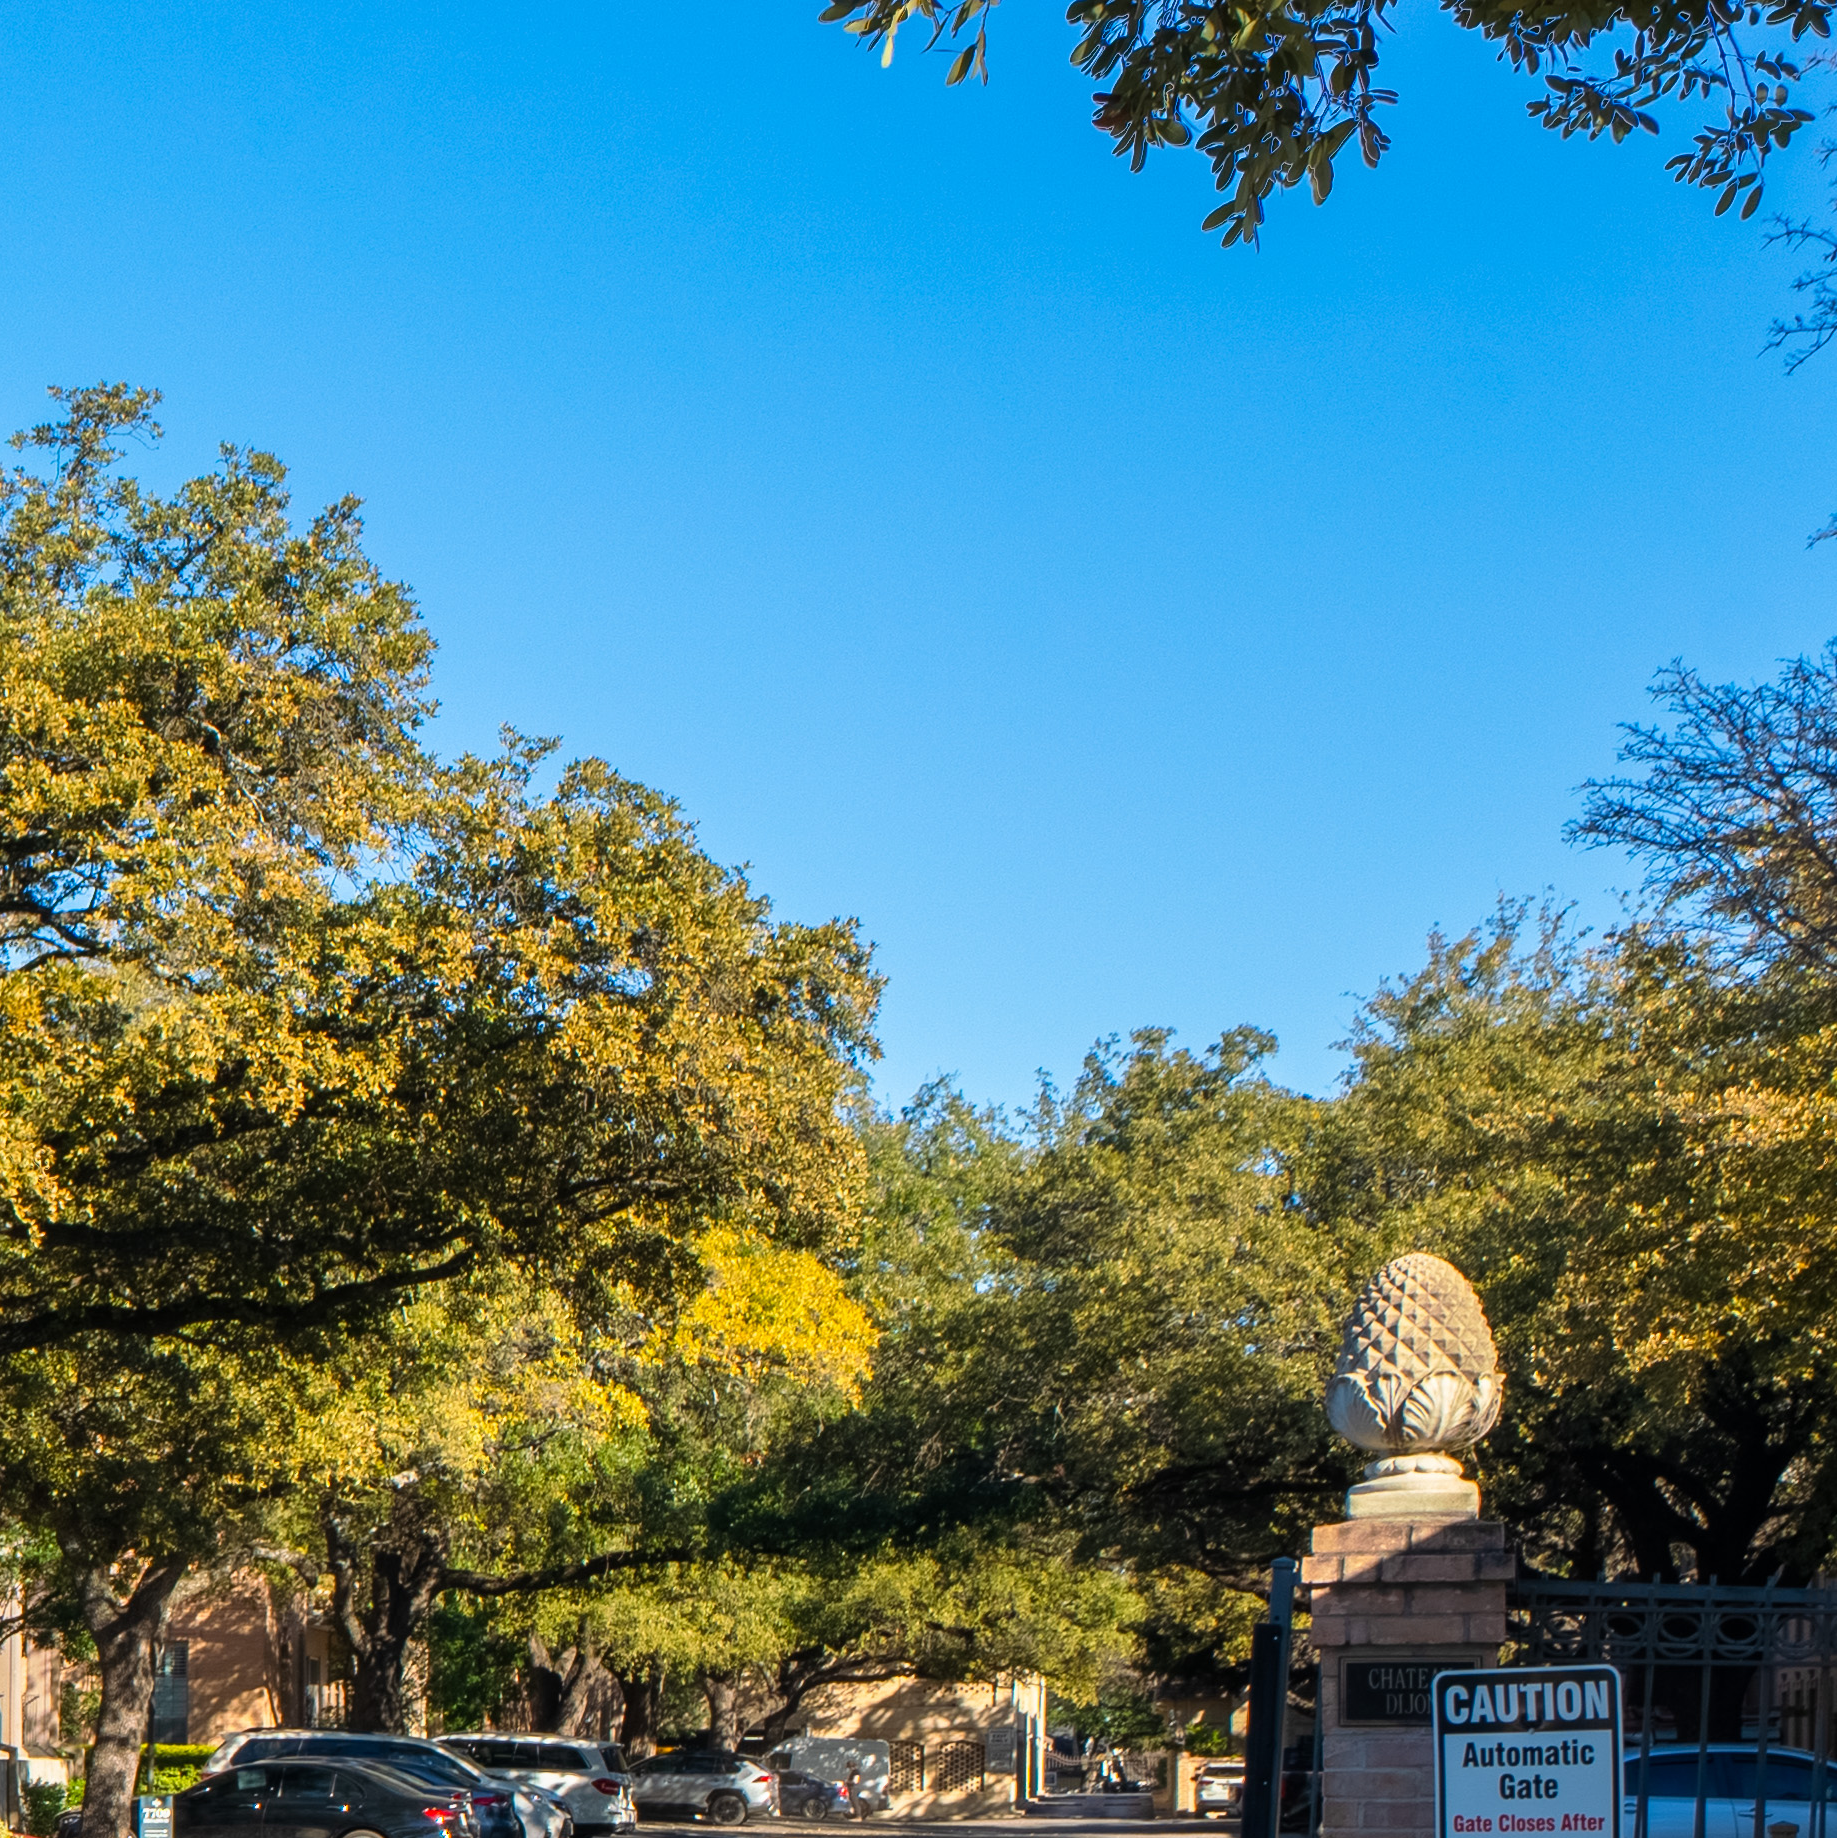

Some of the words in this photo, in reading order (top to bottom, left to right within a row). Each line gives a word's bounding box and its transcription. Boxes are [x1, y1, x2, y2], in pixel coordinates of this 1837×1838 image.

[1368, 1667, 1454, 1690] CHATE
[1444, 1680, 1610, 1725] CAUTION
[1462, 1739, 1595, 1767] Automatic
[1499, 1774, 1559, 1800] Gate
[1453, 1815, 1492, 1832] Gate
[1498, 1814, 1556, 1832] Closes
[1561, 1814, 1605, 1831] After
